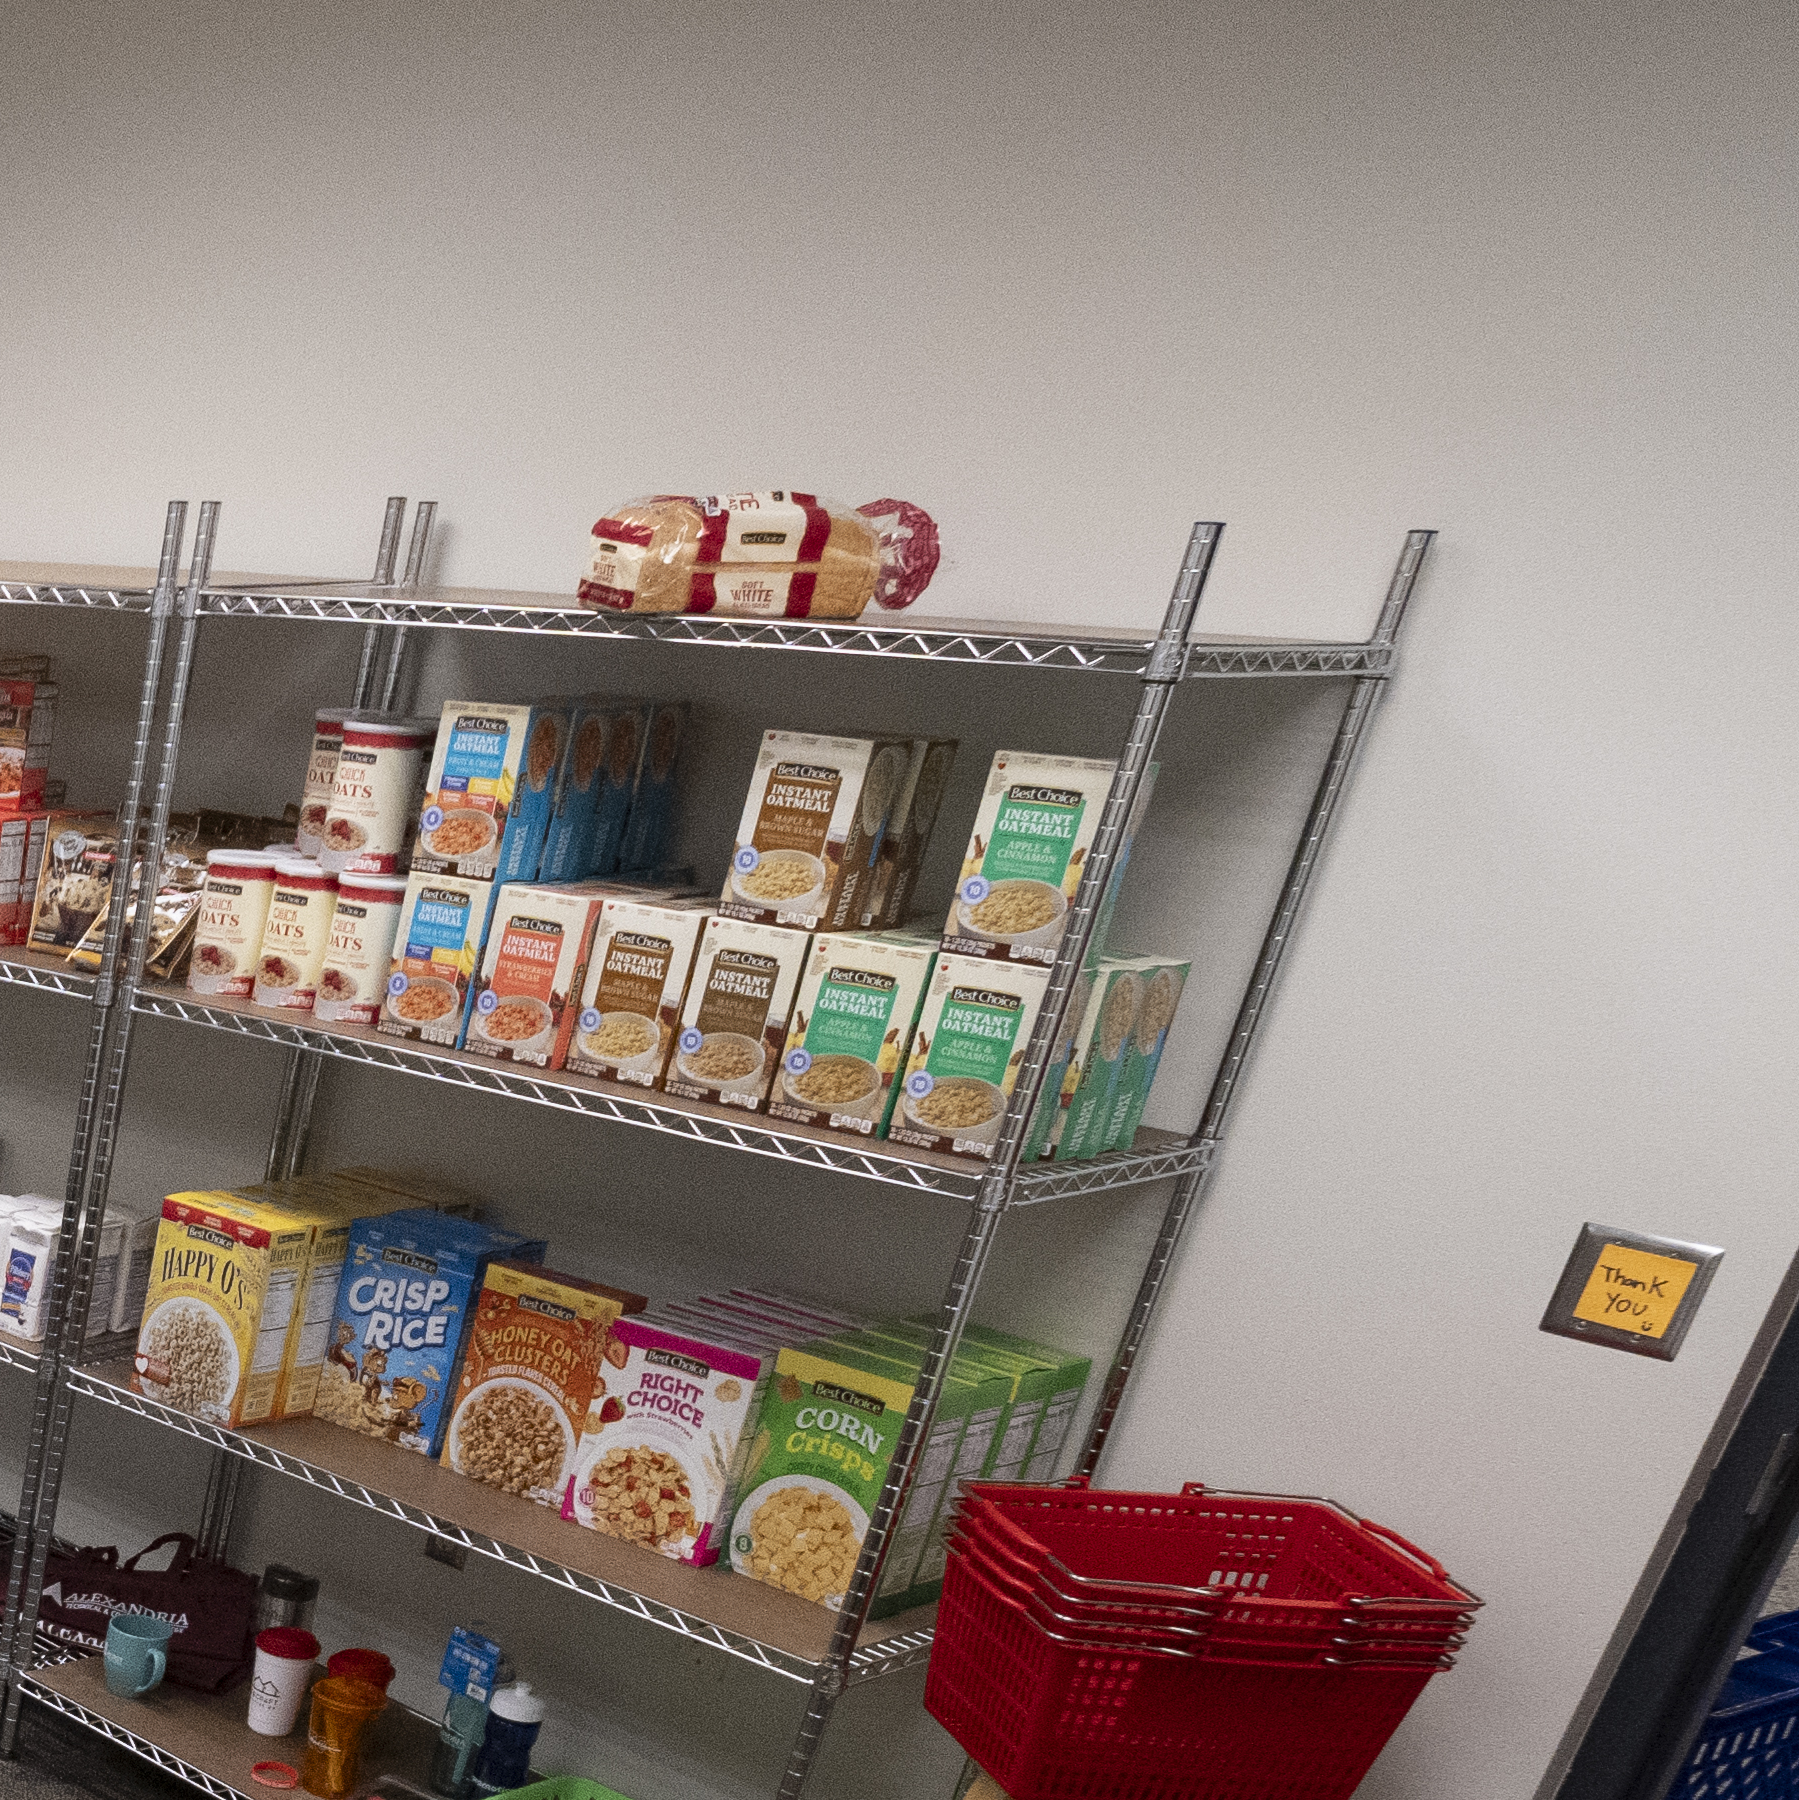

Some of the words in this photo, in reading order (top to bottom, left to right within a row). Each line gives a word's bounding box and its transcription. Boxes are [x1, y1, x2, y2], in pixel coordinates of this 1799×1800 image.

[730, 589, 774, 604] WHITE
[458, 717, 475, 729] Best
[476, 718, 507, 731] Choice
[453, 742, 501, 755] OATMEAL
[457, 733, 501, 745] INSTANT
[777, 764, 799, 778] Best
[800, 765, 837, 782] Choice
[334, 782, 372, 799] OATS
[771, 783, 832, 801] INSTANT
[1010, 787, 1034, 801] Best
[1036, 788, 1079, 806] Choice
[766, 793, 831, 814] OATMEAL
[1004, 808, 1074, 827] INSTANT
[998, 819, 1073, 839] OATMEAL
[996, 848, 1057, 864] CINNAMON
[1007, 840, 1040, 853] APPLE
[422, 889, 439, 900] Best
[440, 890, 469, 904] Choice
[970, 884, 981, 895] 10
[201, 911, 240, 927] OATS
[417, 912, 463, 927] OATMEAL
[421, 903, 463, 917] INSTANT
[267, 922, 304, 938] OATS
[511, 917, 529, 928] Best
[529, 920, 560, 933] Choice
[329, 934, 362, 951] OATS
[506, 935, 557, 951] INSTANT
[615, 933, 636, 944] Best
[637, 935, 668, 950] Choice
[502, 944, 555, 963] OATMEAL
[610, 950, 665, 969] INSTANT
[721, 951, 740, 963] Best
[741, 954, 774, 968] Choice
[606, 961, 664, 980] OATMEAL
[714, 968, 771, 987] INSTANT
[831, 969, 853, 983] Best
[854, 972, 893, 989] Choice
[709, 978, 769, 999] OATMEAL
[824, 988, 889, 1008] INSTANT
[953, 989, 977, 1003] Best
[978, 992, 1018, 1009] Choice
[818, 998, 887, 1020] OATMEAL
[948, 1008, 1013, 1029] INSTANT
[941, 1020, 1012, 1041] OATMEAL
[940, 1045, 998, 1064] CINNAMON
[951, 1038, 980, 1052] APPLE
[188, 1226, 206, 1242] Best
[207, 1229, 233, 1249] Choice
[161, 1247, 218, 1282] HAPPY
[385, 1250, 405, 1265] Best
[406, 1252, 438, 1272] Choice
[348, 1276, 450, 1315] CRISP
[518, 1297, 539, 1312] Best
[540, 1301, 575, 1320] Choice
[364, 1310, 448, 1351] RICE
[491, 1325, 549, 1351] HONEY
[550, 1340, 581, 1367] OAT
[493, 1344, 570, 1386] CLUSTERS
[647, 1350, 675, 1369] Best
[676, 1355, 708, 1377] Choice
[640, 1372, 705, 1403] RIGHT
[815, 1382, 845, 1402] Best
[847, 1387, 884, 1415] Choice
[626, 1391, 705, 1428] CHOICE
[626, 1410, 645, 1422] with
[646, 1413, 694, 1440] Strawberries
[794, 1407, 886, 1454] CORN
[785, 1432, 876, 1485] Crisps
[581, 1490, 594, 1504] 10
[64, 1592, 189, 1626] ALEXANDRIA
